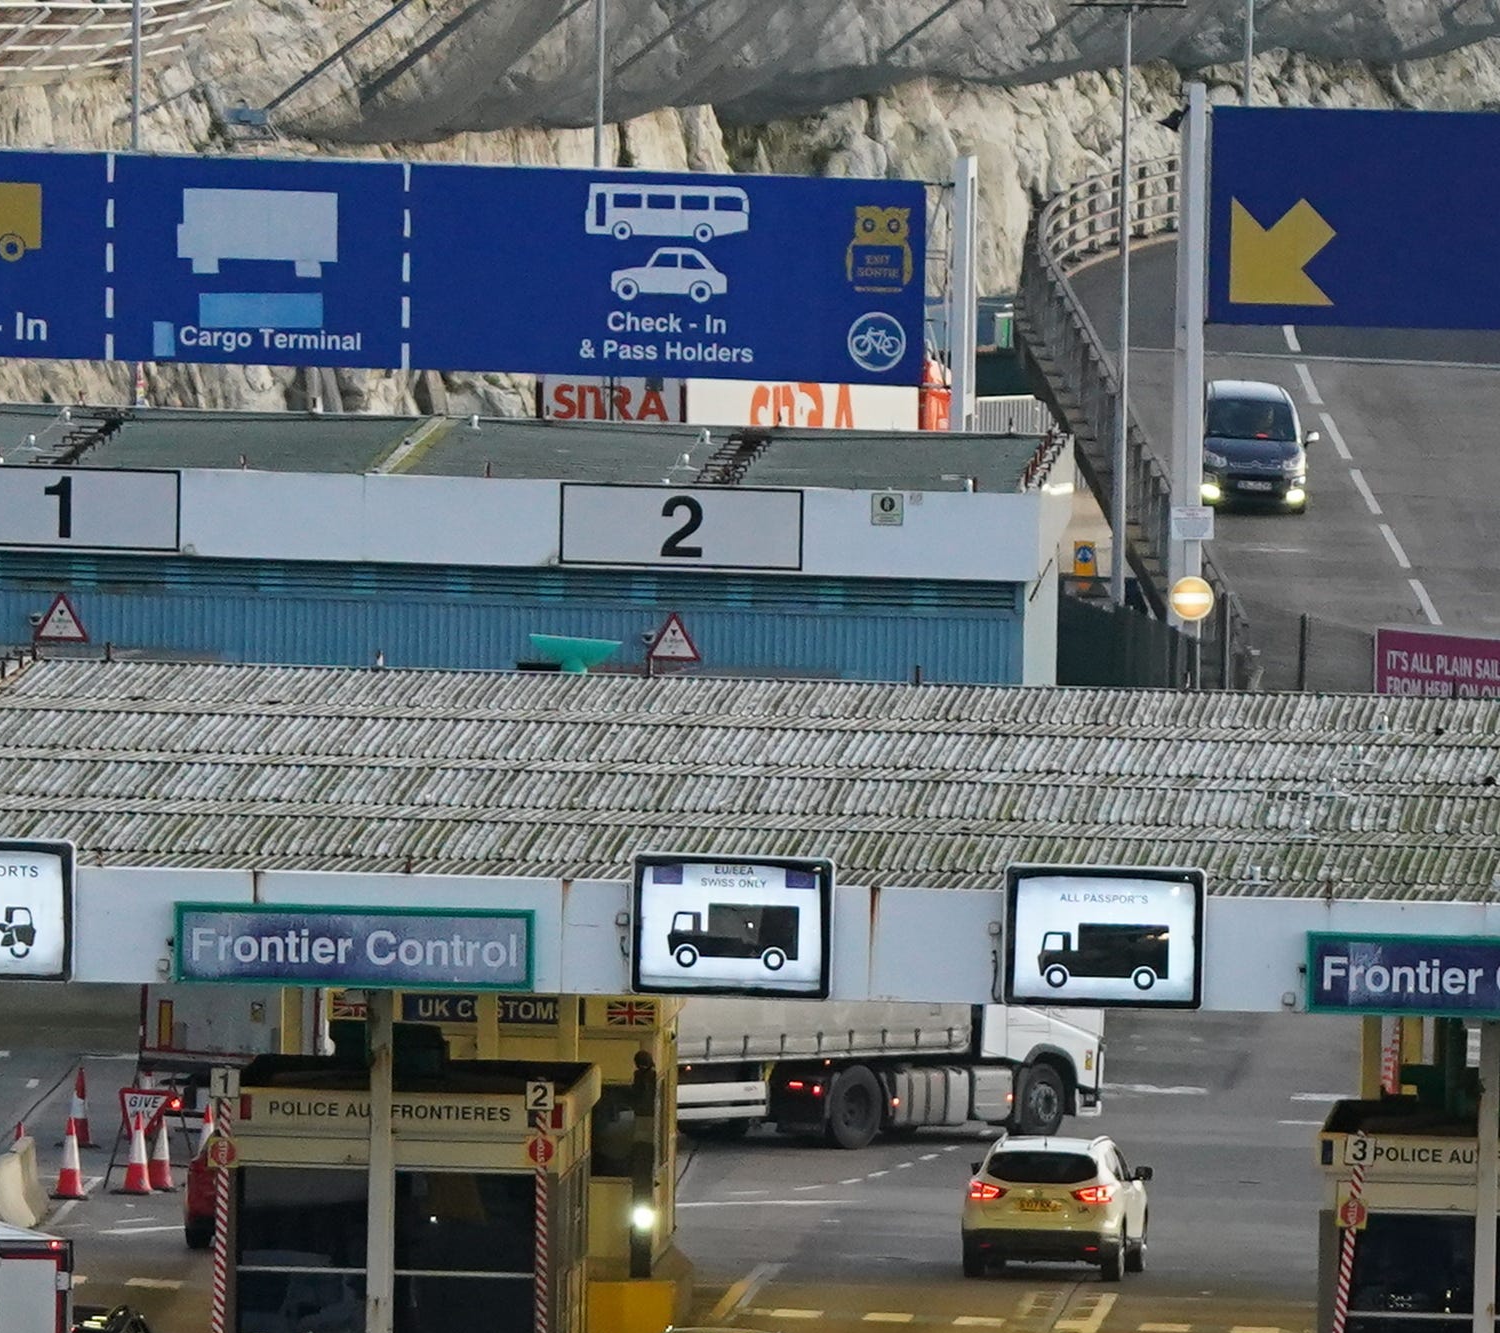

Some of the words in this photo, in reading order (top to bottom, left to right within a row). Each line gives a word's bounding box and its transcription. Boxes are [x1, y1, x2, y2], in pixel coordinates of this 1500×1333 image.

[17, 311, 47, 341] In
[607, 311, 681, 333] Check
[705, 314, 726, 334] In
[180, 326, 251, 352] Cargo
[260, 329, 361, 351] Terminal
[580, 341, 595, 358] &
[603, 339, 658, 360] Pass
[665, 342, 753, 363] Holders
[45, 476, 72, 538] 1
[660, 495, 703, 558] 2
[1411, 655, 1433, 675] ALL
[1437, 657, 1473, 677] PLAIN
[1386, 677, 1421, 696] FROM
[701, 877, 735, 887] SWISS
[739, 878, 767, 888] ONLY
[1060, 893, 1080, 903] ALL
[190, 927, 353, 966] Frontier
[366, 930, 518, 968] Control
[1323, 955, 1482, 994] Frontier
[418, 1000, 453, 1019] UK
[129, 1096, 160, 1108] GIVE
[533, 1084, 548, 1106] 2
[269, 1101, 344, 1118] POLICE
[347, 1102, 370, 1118] AU
[392, 1104, 511, 1122] FRONTIERES
[1351, 1140, 1367, 1161] 3
[1373, 1146, 1442, 1164] POLICE
